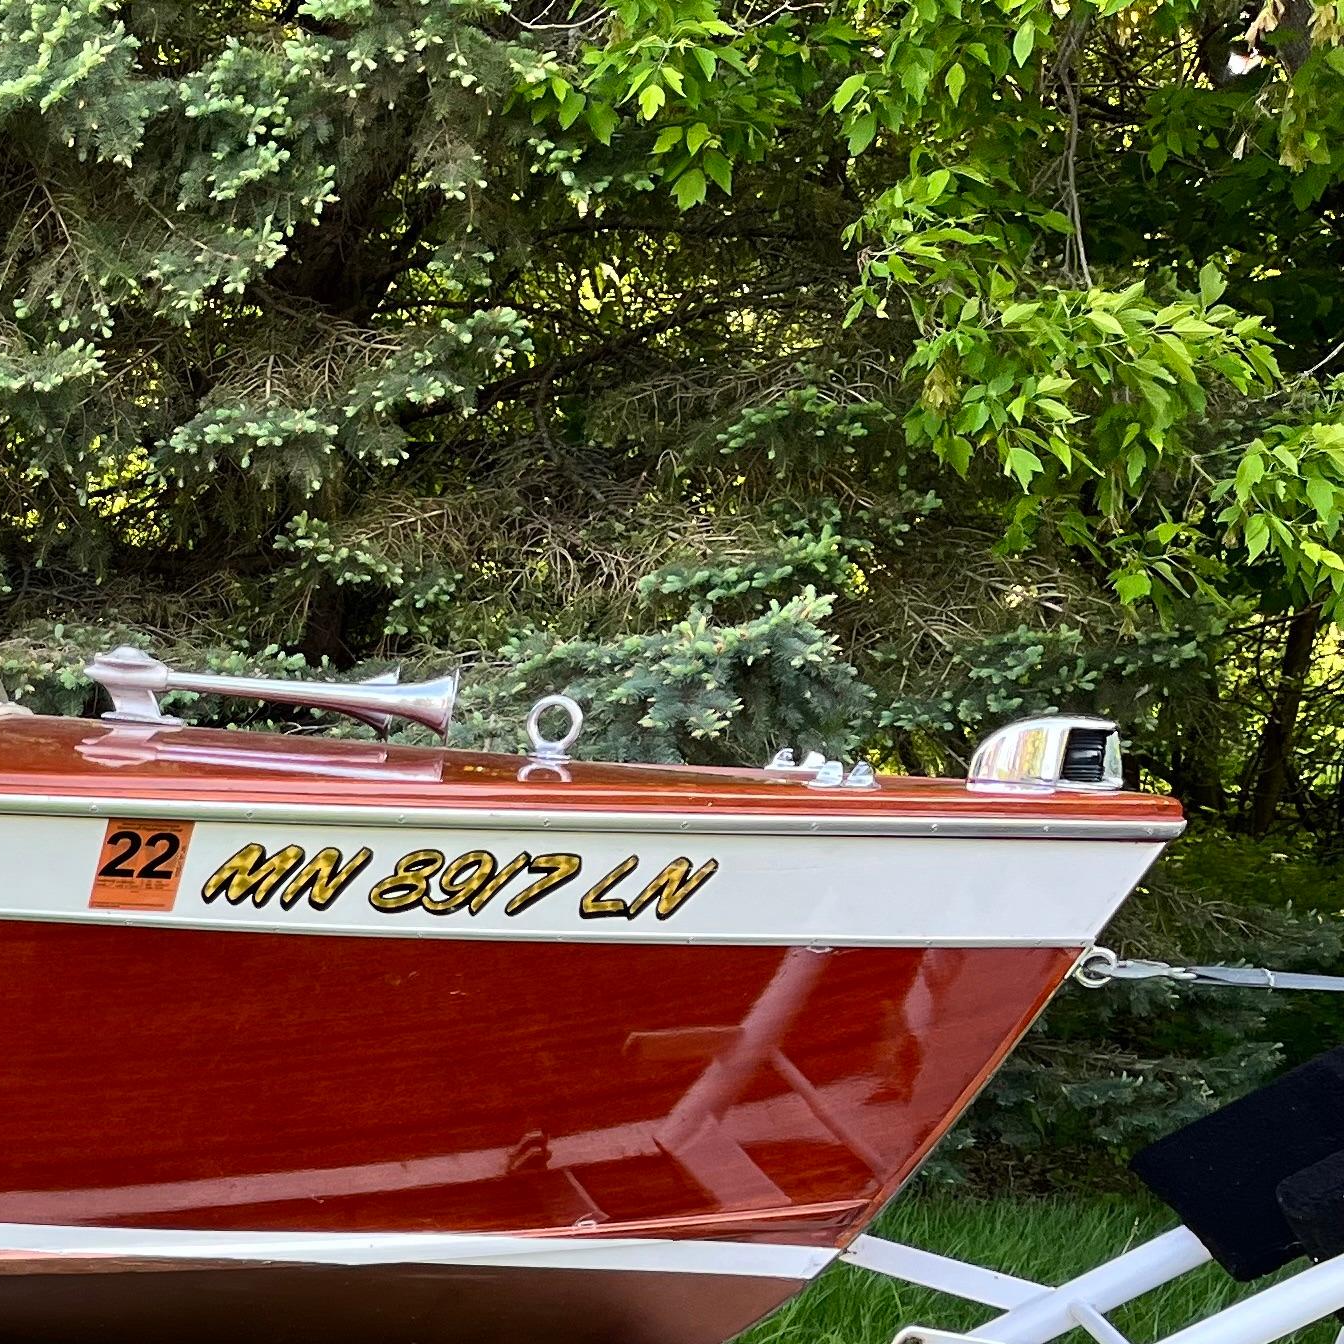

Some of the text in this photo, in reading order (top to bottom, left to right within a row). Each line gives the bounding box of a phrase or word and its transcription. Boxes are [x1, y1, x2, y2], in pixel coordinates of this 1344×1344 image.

[98, 830, 180, 880] 22
[201, 842, 374, 912] MN
[368, 849, 583, 918] 8917
[579, 854, 720, 921] LN
